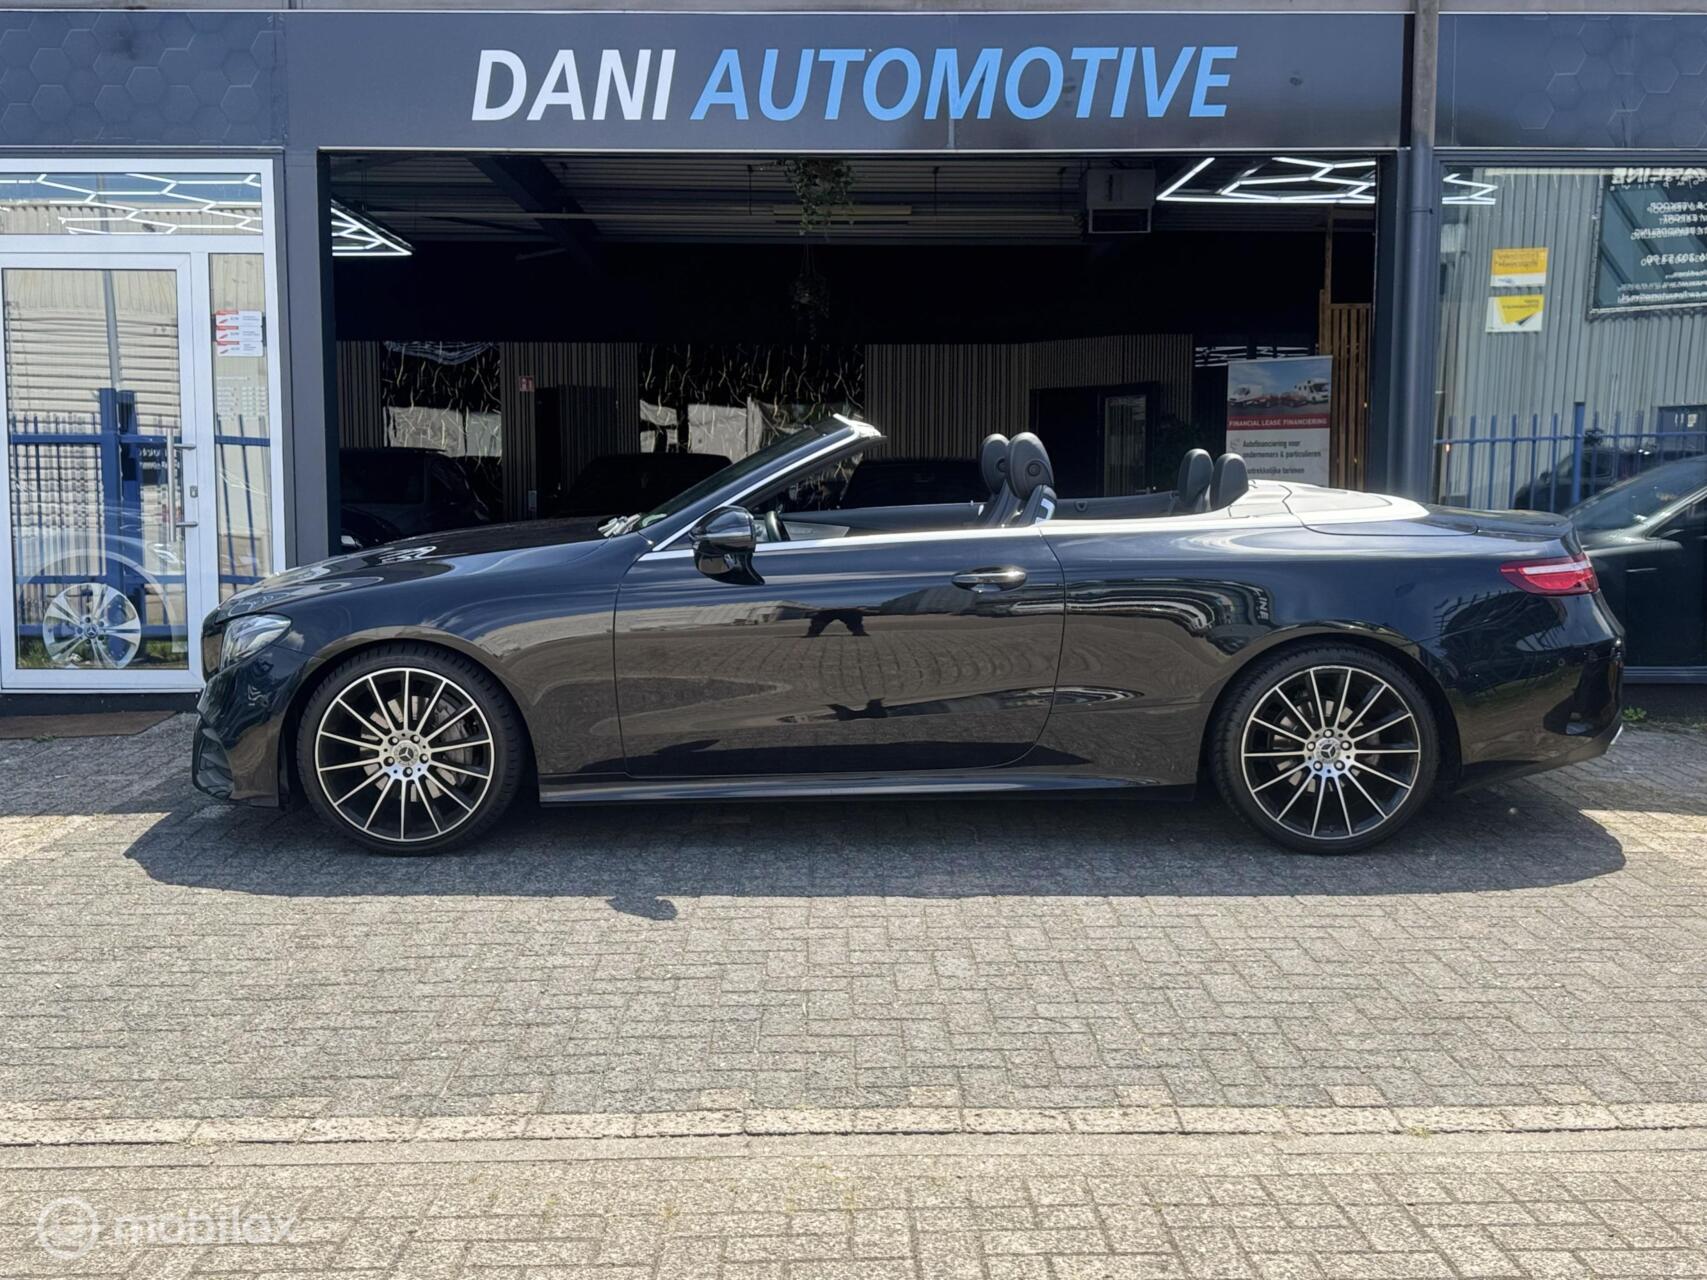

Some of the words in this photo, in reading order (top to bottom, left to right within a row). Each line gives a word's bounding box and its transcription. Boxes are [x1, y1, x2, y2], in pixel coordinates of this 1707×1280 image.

[472, 48, 676, 121] DANI
[690, 46, 1239, 121] AUTOMOTIVE
[1229, 419, 1260, 427] FINANCIAL
